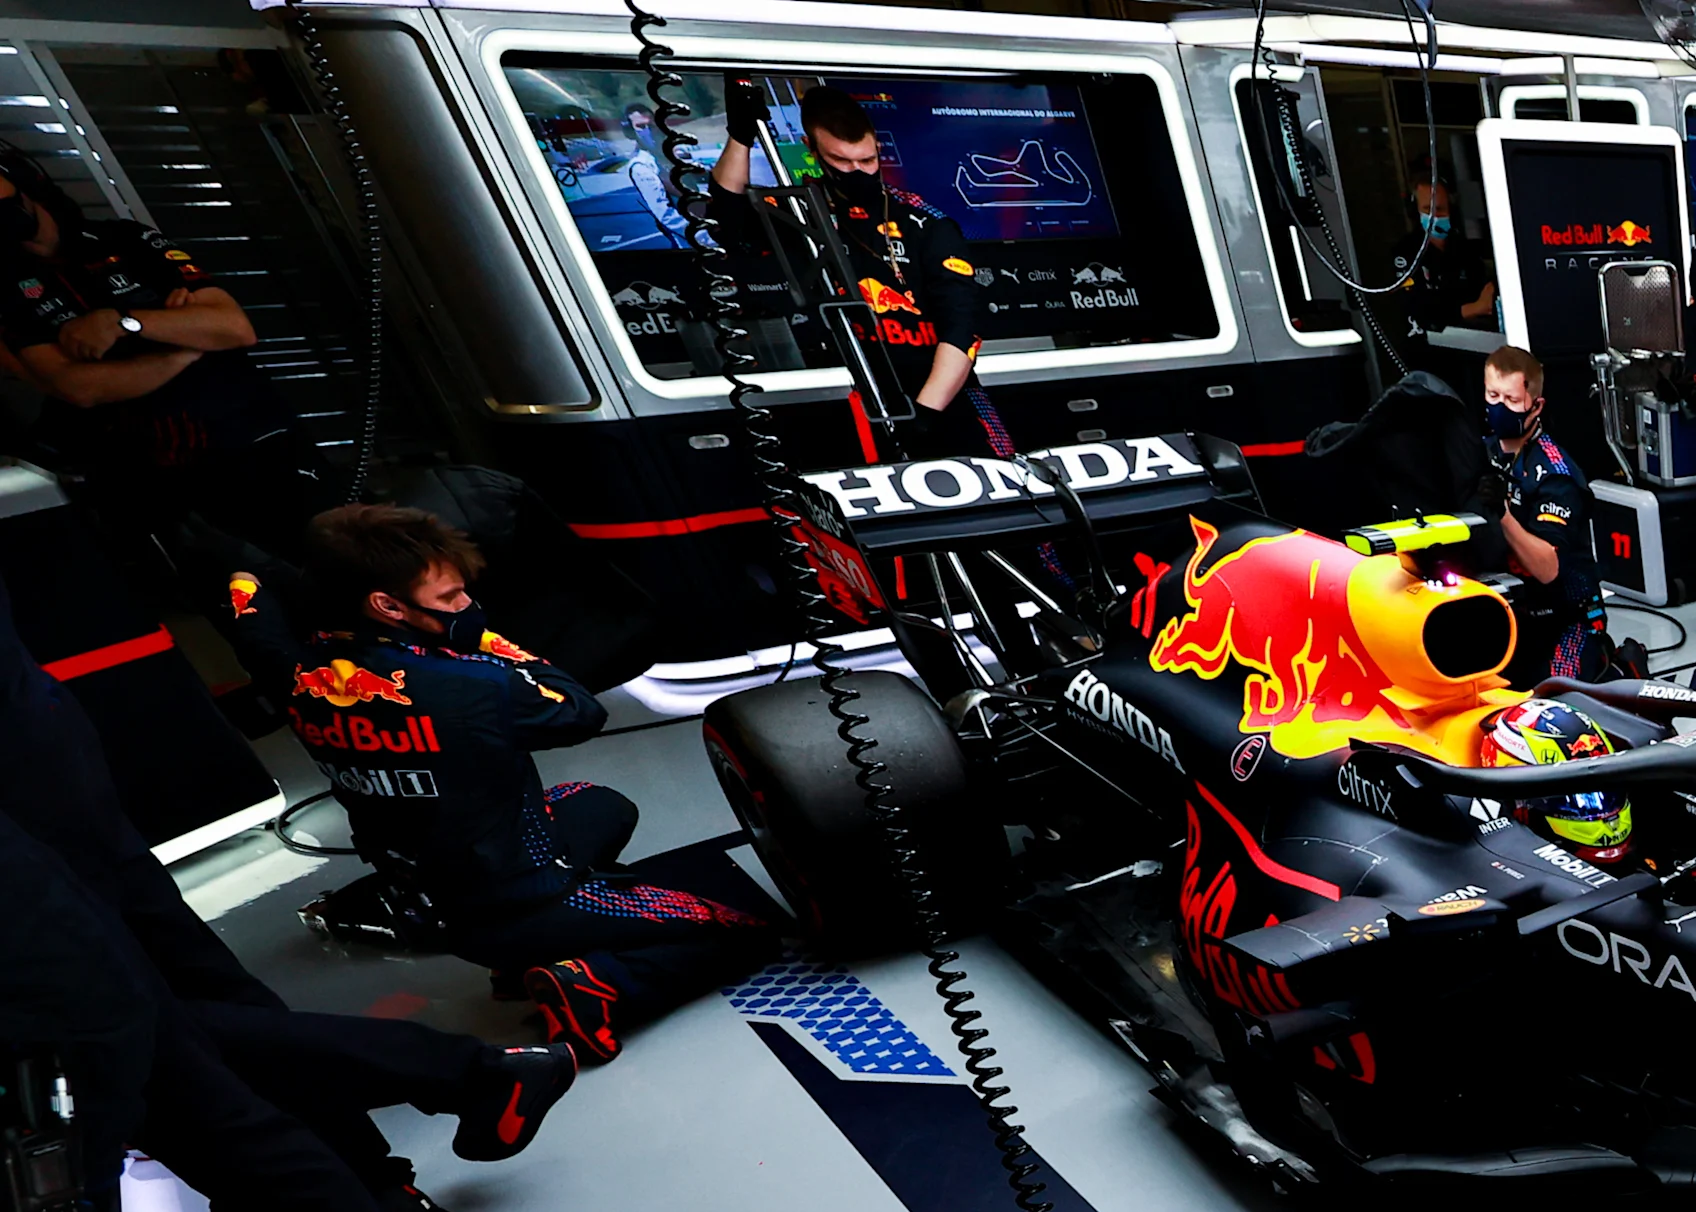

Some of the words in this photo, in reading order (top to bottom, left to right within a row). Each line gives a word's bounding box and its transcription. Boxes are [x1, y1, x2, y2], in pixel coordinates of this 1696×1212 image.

[979, 108, 1033, 118] INTERNACIONAL
[1034, 110, 1045, 118] DO
[1541, 224, 1572, 245] Red
[1574, 224, 1603, 245] Bull
[1545, 256, 1654, 271] RAC
[747, 280, 783, 293] Walmart
[1028, 269, 1058, 282] citrix
[1070, 289, 1106, 309] Red
[1106, 287, 1139, 307] Bull
[627, 312, 654, 336] ed
[882, 317, 937, 346] Bull
[799, 435, 1204, 518] HONDA
[1540, 501, 1572, 519] citrix
[1611, 531, 1631, 559] 11
[349, 712, 441, 753] Bull
[1063, 668, 1187, 775] HONDA
[1337, 763, 1399, 820] citrix
[1478, 817, 1512, 835] INTER
[1533, 843, 1598, 882] Mobil
